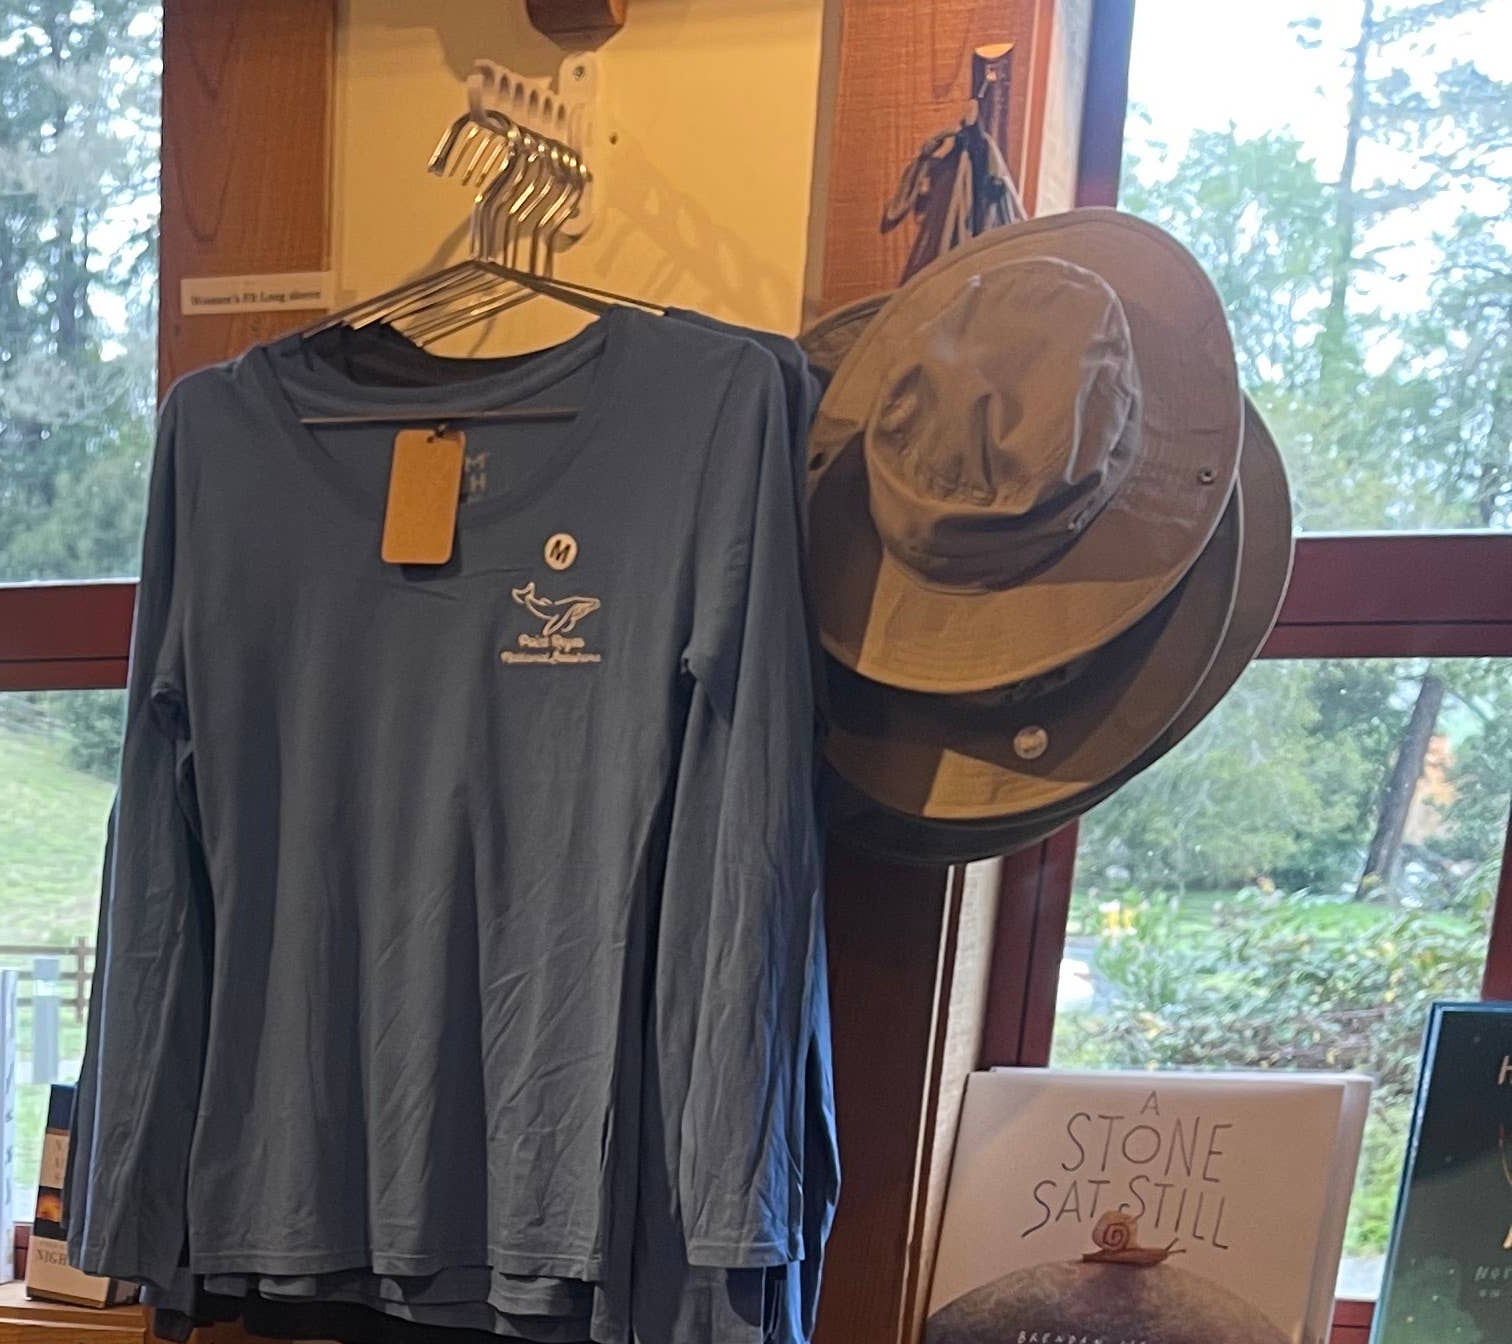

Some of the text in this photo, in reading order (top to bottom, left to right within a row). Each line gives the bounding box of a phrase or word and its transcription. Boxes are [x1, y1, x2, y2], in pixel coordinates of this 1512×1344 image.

[549, 539, 572, 564] M
[1140, 1090, 1159, 1117] A
[1061, 1112, 1233, 1183] STONE
[1021, 1175, 1232, 1250] SAT STILL
